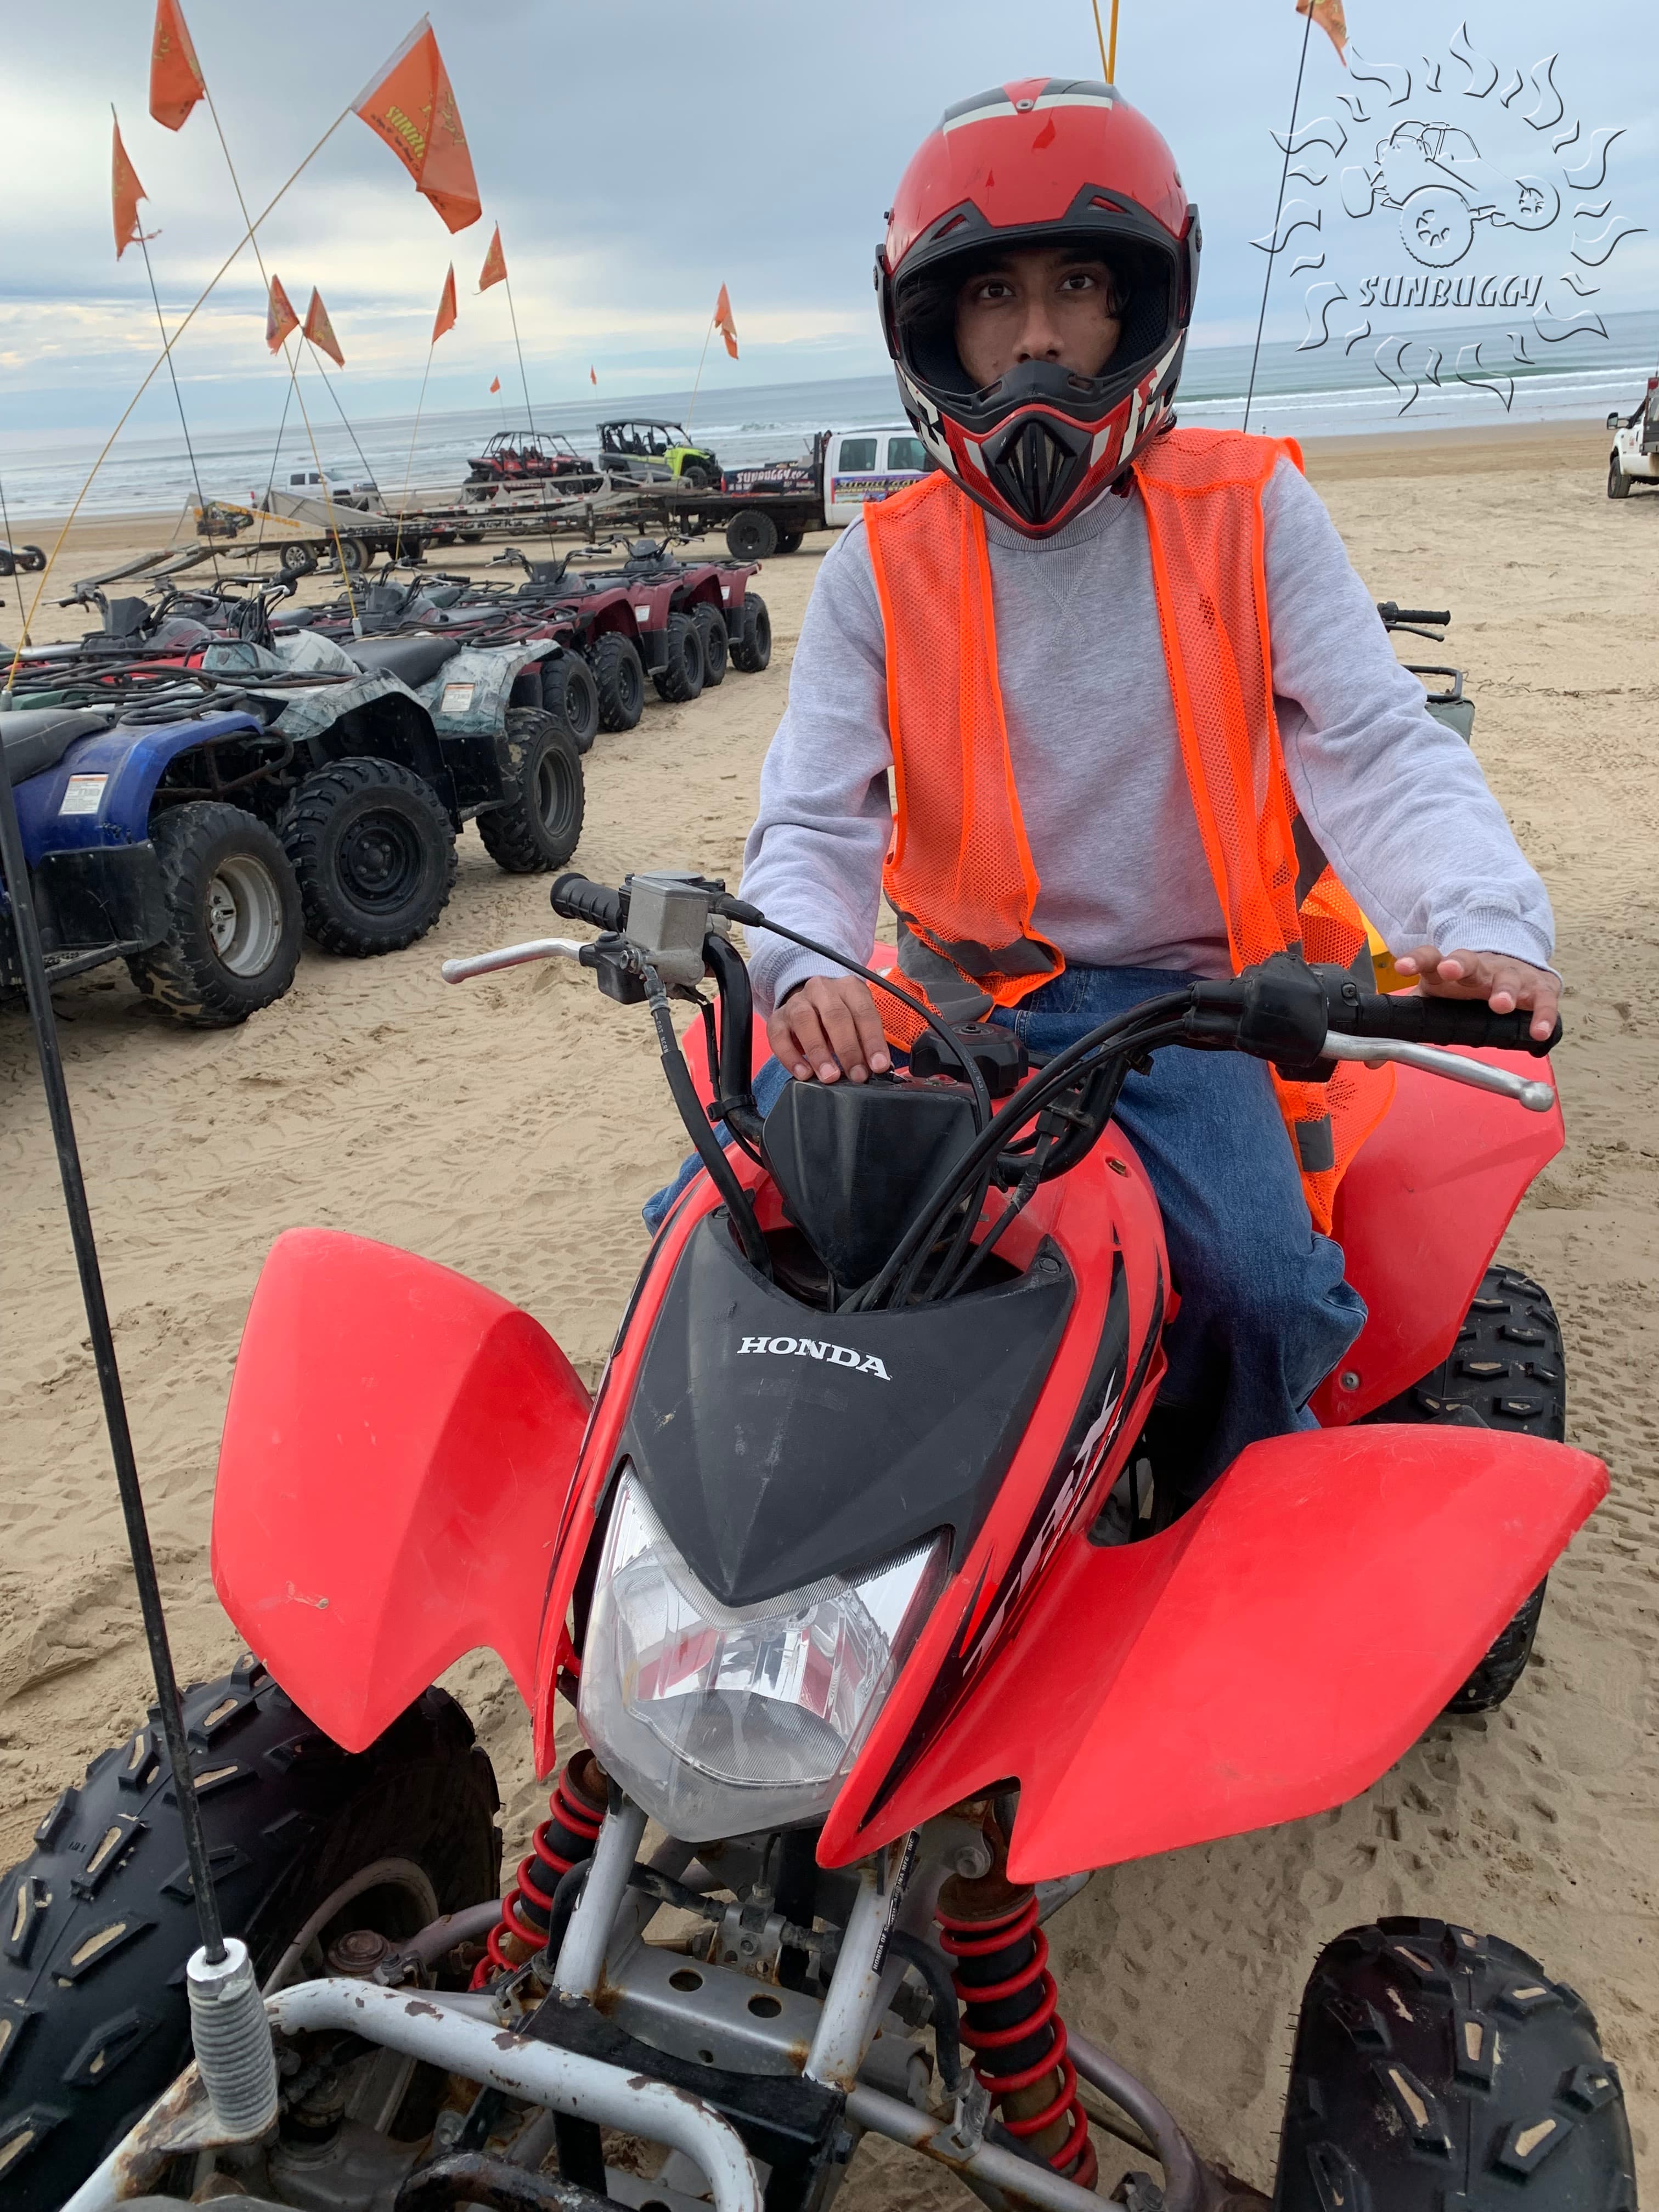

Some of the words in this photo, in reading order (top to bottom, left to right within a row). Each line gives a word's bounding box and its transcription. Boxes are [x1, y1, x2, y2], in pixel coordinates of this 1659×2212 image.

[737, 1337, 891, 1381] HONDA
[963, 1368, 1119, 1677] TRX
[873, 1944, 883, 1970] HONDA
[881, 1932, 887, 1943] OF
